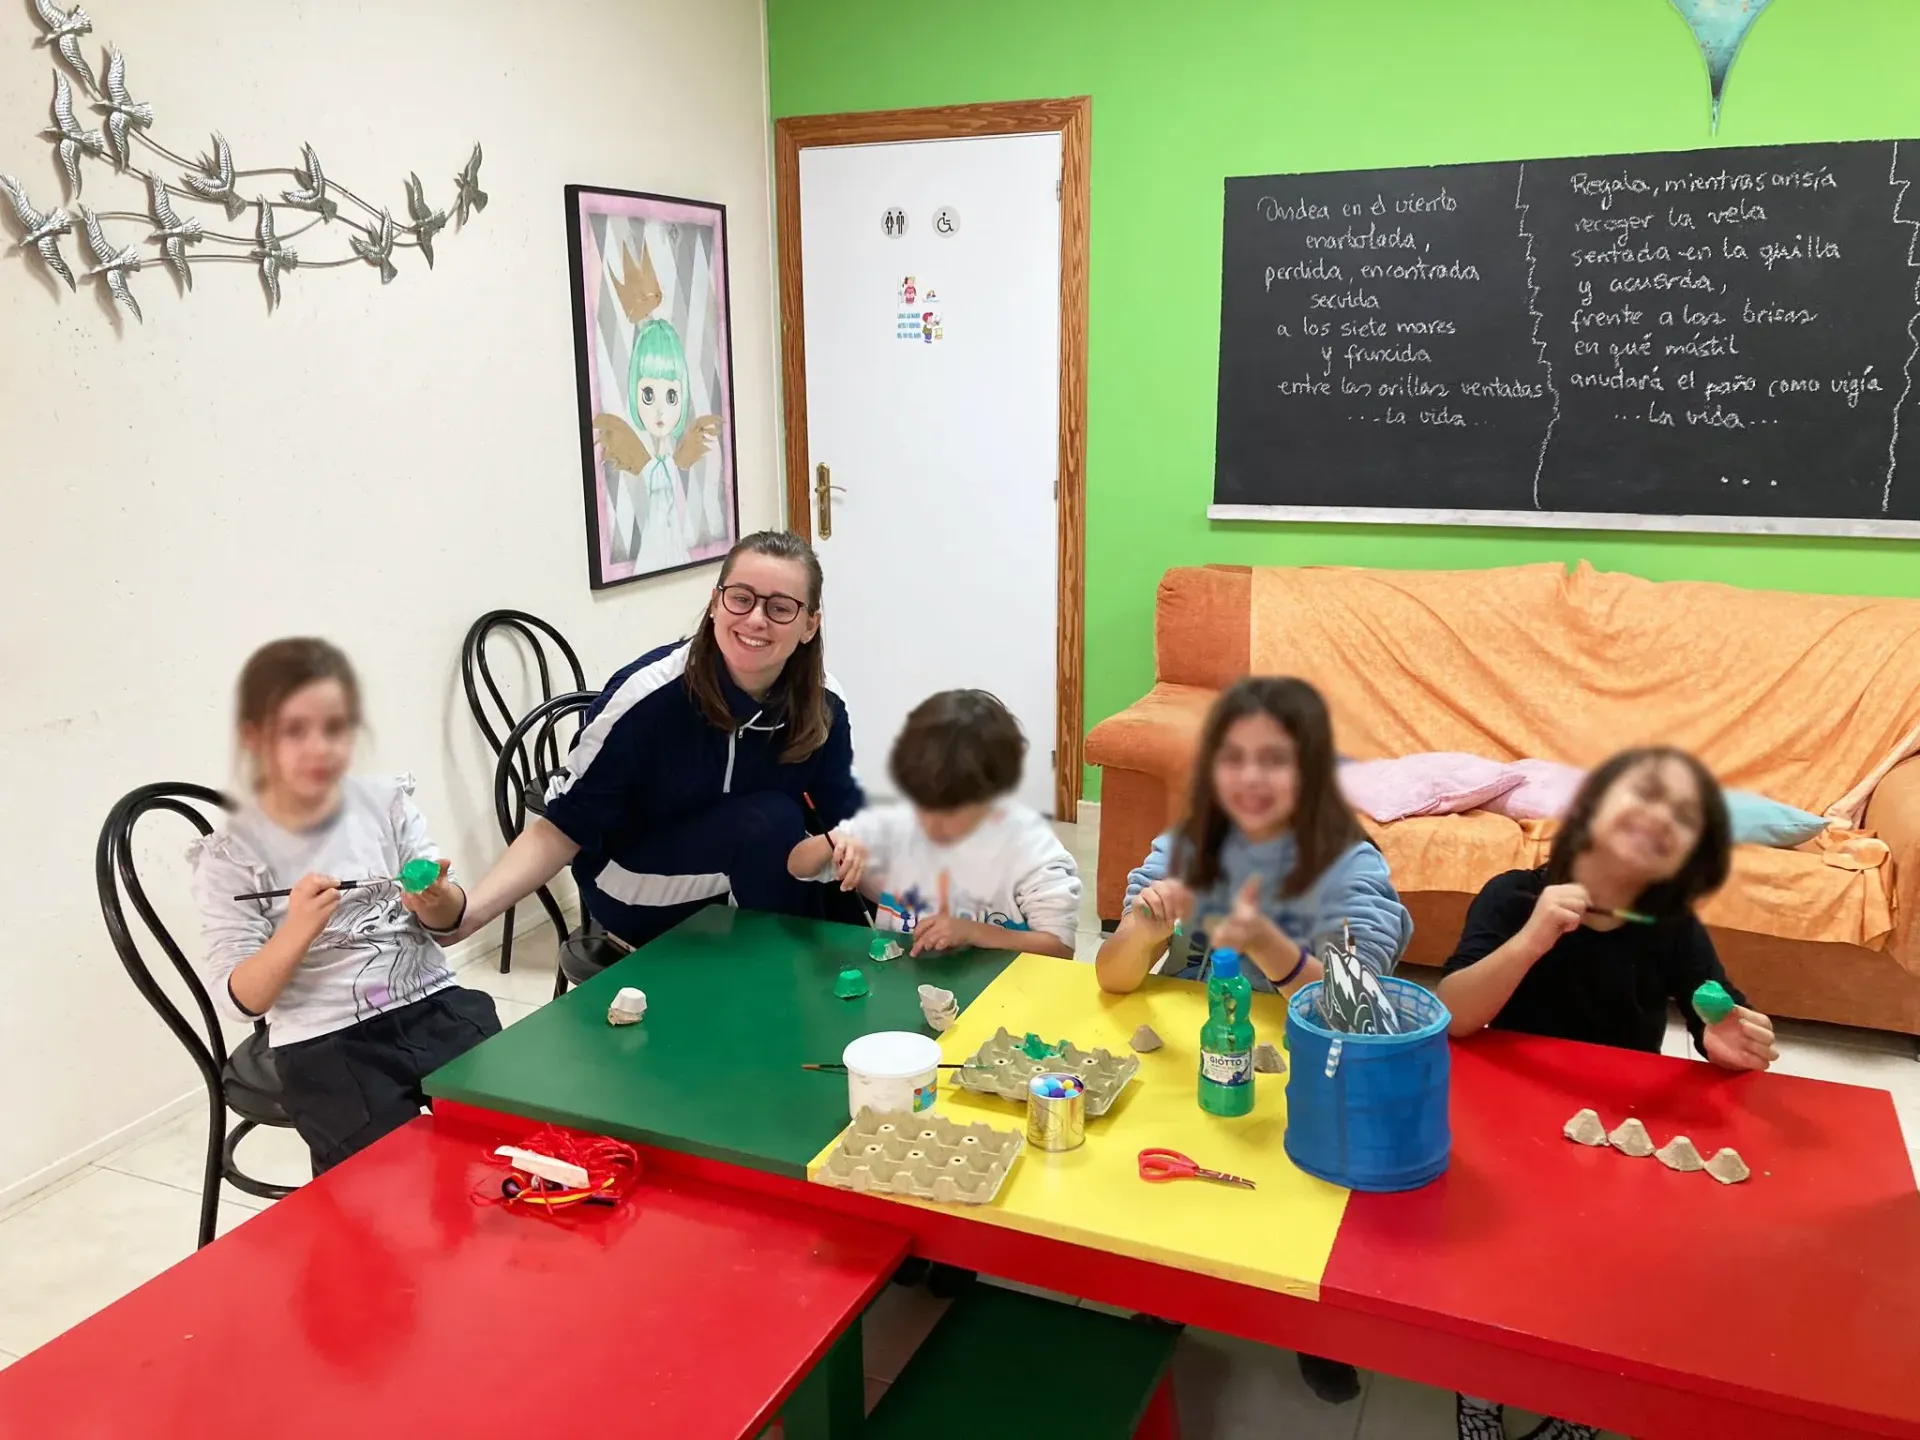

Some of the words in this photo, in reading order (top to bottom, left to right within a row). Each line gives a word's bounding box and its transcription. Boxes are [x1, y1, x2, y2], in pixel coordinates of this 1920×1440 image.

[1664, 168, 1766, 193] mientras
[1342, 200, 1362, 218] en
[1369, 192, 1386, 216] el
[1394, 186, 1457, 215] viento
[1574, 213, 1655, 246] recoger
[1667, 207, 1696, 230] la
[1706, 198, 1768, 225] vela
[1570, 242, 1671, 267] sentada
[1677, 245, 1714, 262] en
[1722, 236, 1749, 261] la
[1758, 233, 1842, 271] quilla
[1360, 256, 1480, 283] encontrada
[1309, 286, 1381, 310] servida
[1578, 279, 1594, 307] y
[1276, 322, 1292, 338] a
[1303, 317, 1331, 338] los
[1340, 318, 1387, 338] siete
[1396, 318, 1456, 336] mares
[1570, 302, 1643, 334] frente
[1658, 311, 1674, 327] a
[1682, 303, 1728, 327] las
[1741, 298, 1819, 325] brisas
[1321, 345, 1333, 377] y
[1573, 340, 1600, 357] en
[1609, 332, 1653, 368] qué
[1664, 333, 1741, 357] mástil
[1277, 374, 1331, 397] entre
[1341, 374, 1372, 396] las
[1378, 373, 1449, 399] orillas
[1460, 376, 1544, 400] ventadas
[1569, 365, 1665, 393] anudará
[1677, 370, 1696, 391] el
[1705, 374, 1757, 402] paño
[1768, 379, 1820, 398] como
[1830, 364, 1884, 408] vigía
[1209, 1055, 1242, 1066] GIOTTO
